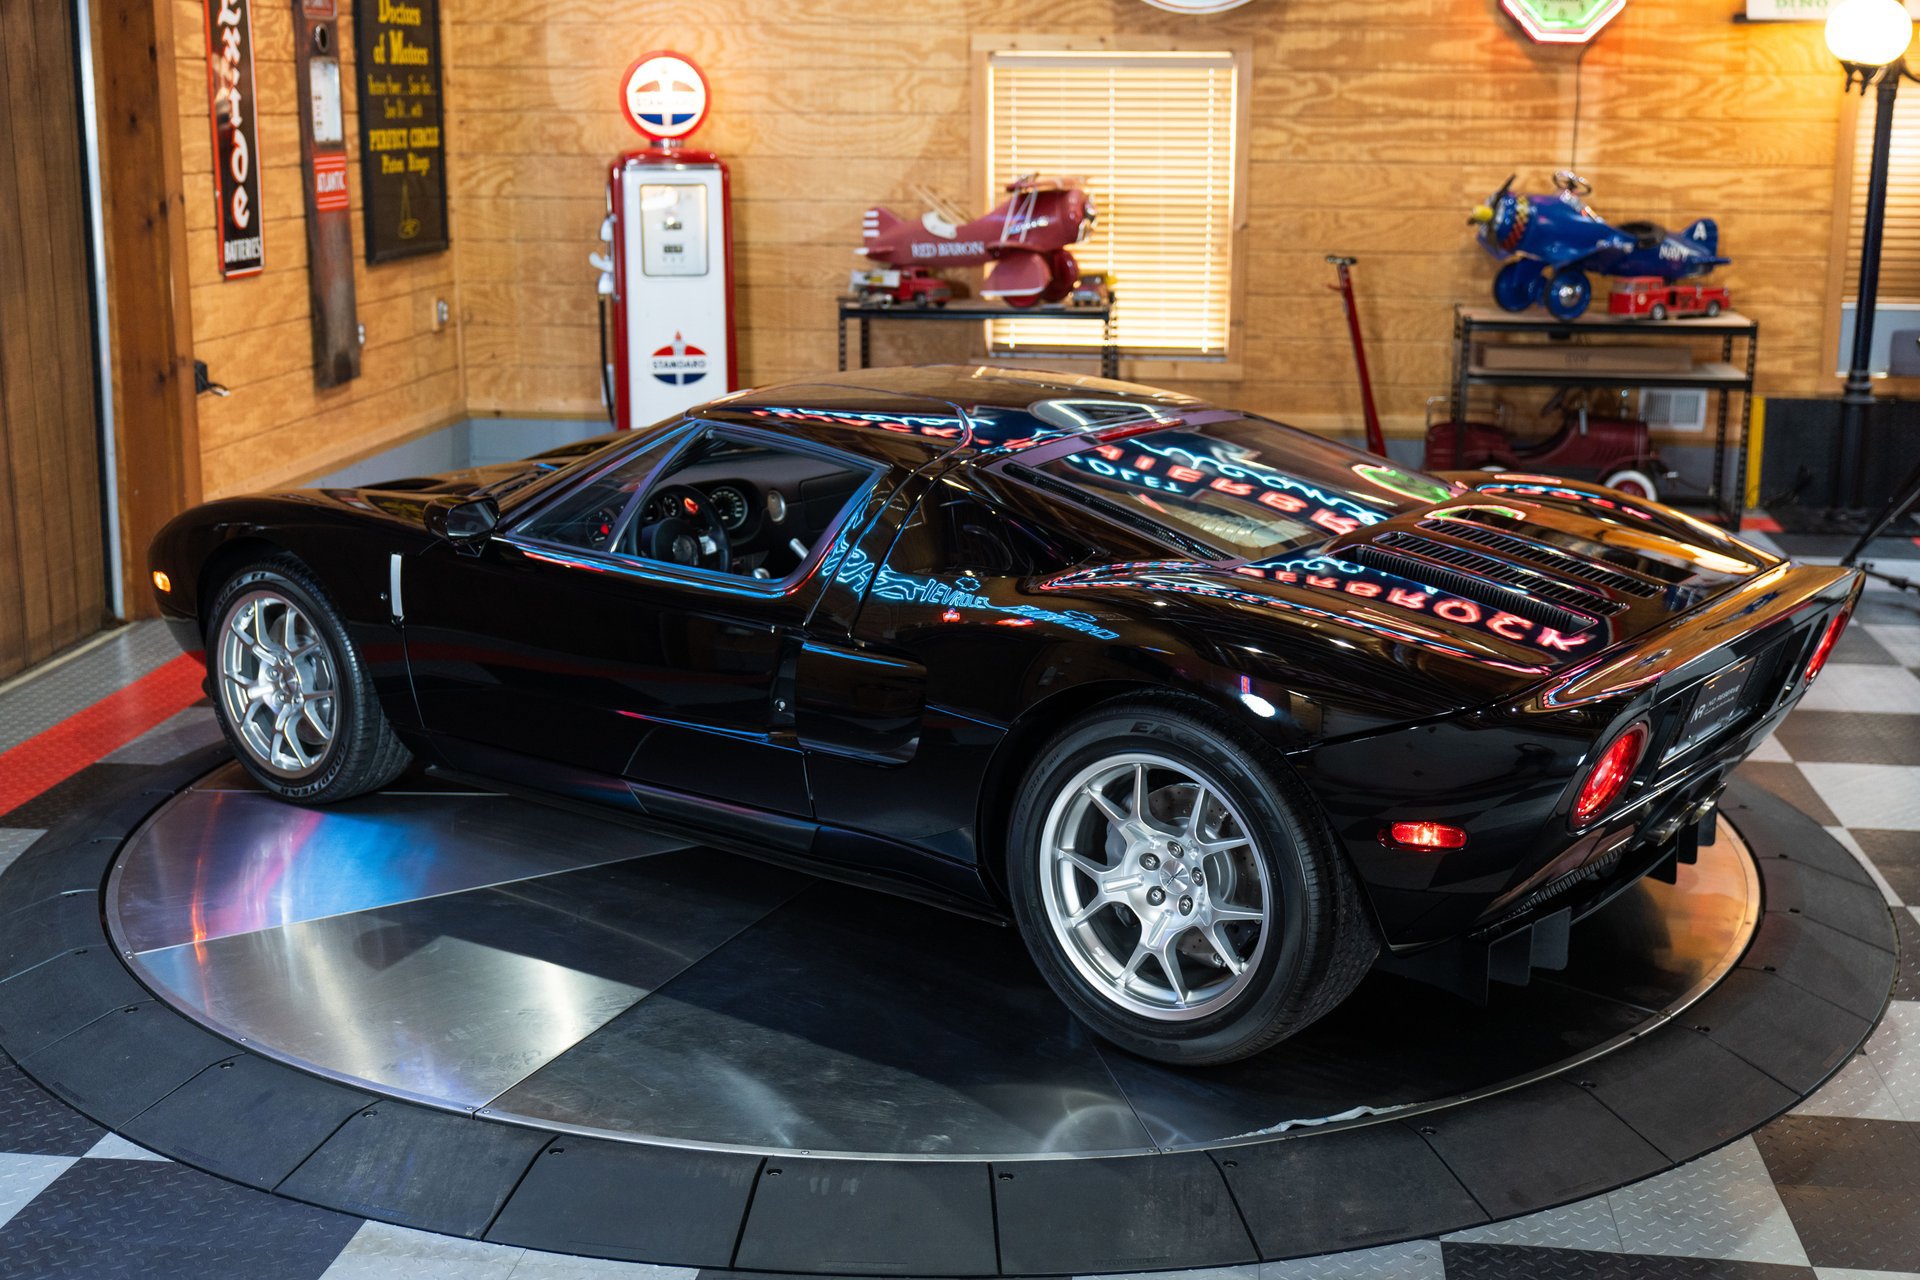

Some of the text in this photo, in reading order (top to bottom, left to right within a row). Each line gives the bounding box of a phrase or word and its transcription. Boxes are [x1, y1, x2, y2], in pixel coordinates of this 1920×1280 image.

[224, 237, 260, 263] BATTERIES
[911, 240, 985, 258] RED BARON
[1658, 245, 1690, 262] NAVY
[652, 360, 706, 369] STANDARD
[280, 742, 346, 795] GOODYEAR
